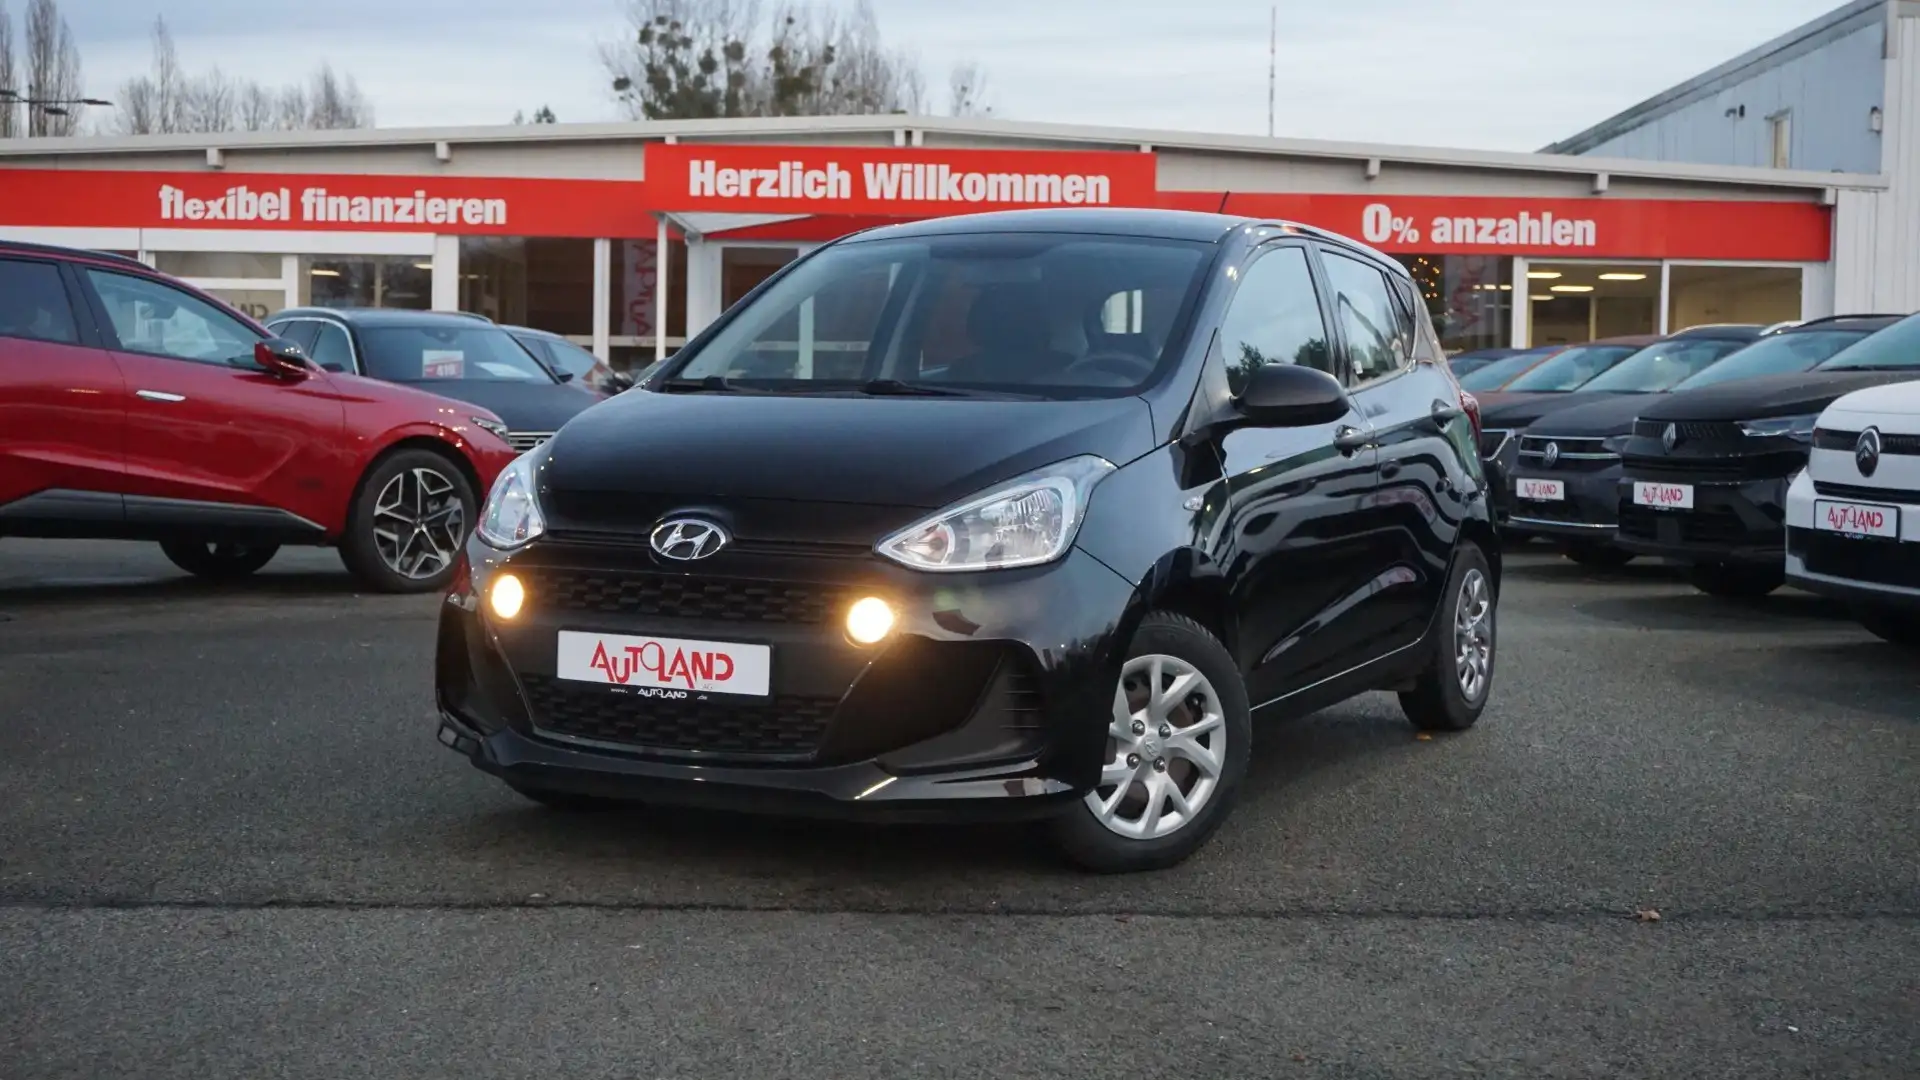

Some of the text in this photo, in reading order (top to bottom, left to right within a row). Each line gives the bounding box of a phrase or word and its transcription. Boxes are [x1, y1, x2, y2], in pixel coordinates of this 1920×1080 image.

[689, 159, 1110, 205] Herzlich Willkommen
[159, 184, 507, 226] flexibel finanzieren
[1361, 202, 1597, 247] 0% anzahlen
[1642, 484, 1684, 504] AUTOLAND
[1827, 505, 1884, 532] AUTOLAND
[589, 639, 735, 690] AUTOLAND
[637, 687, 688, 700] AUTOLAND
